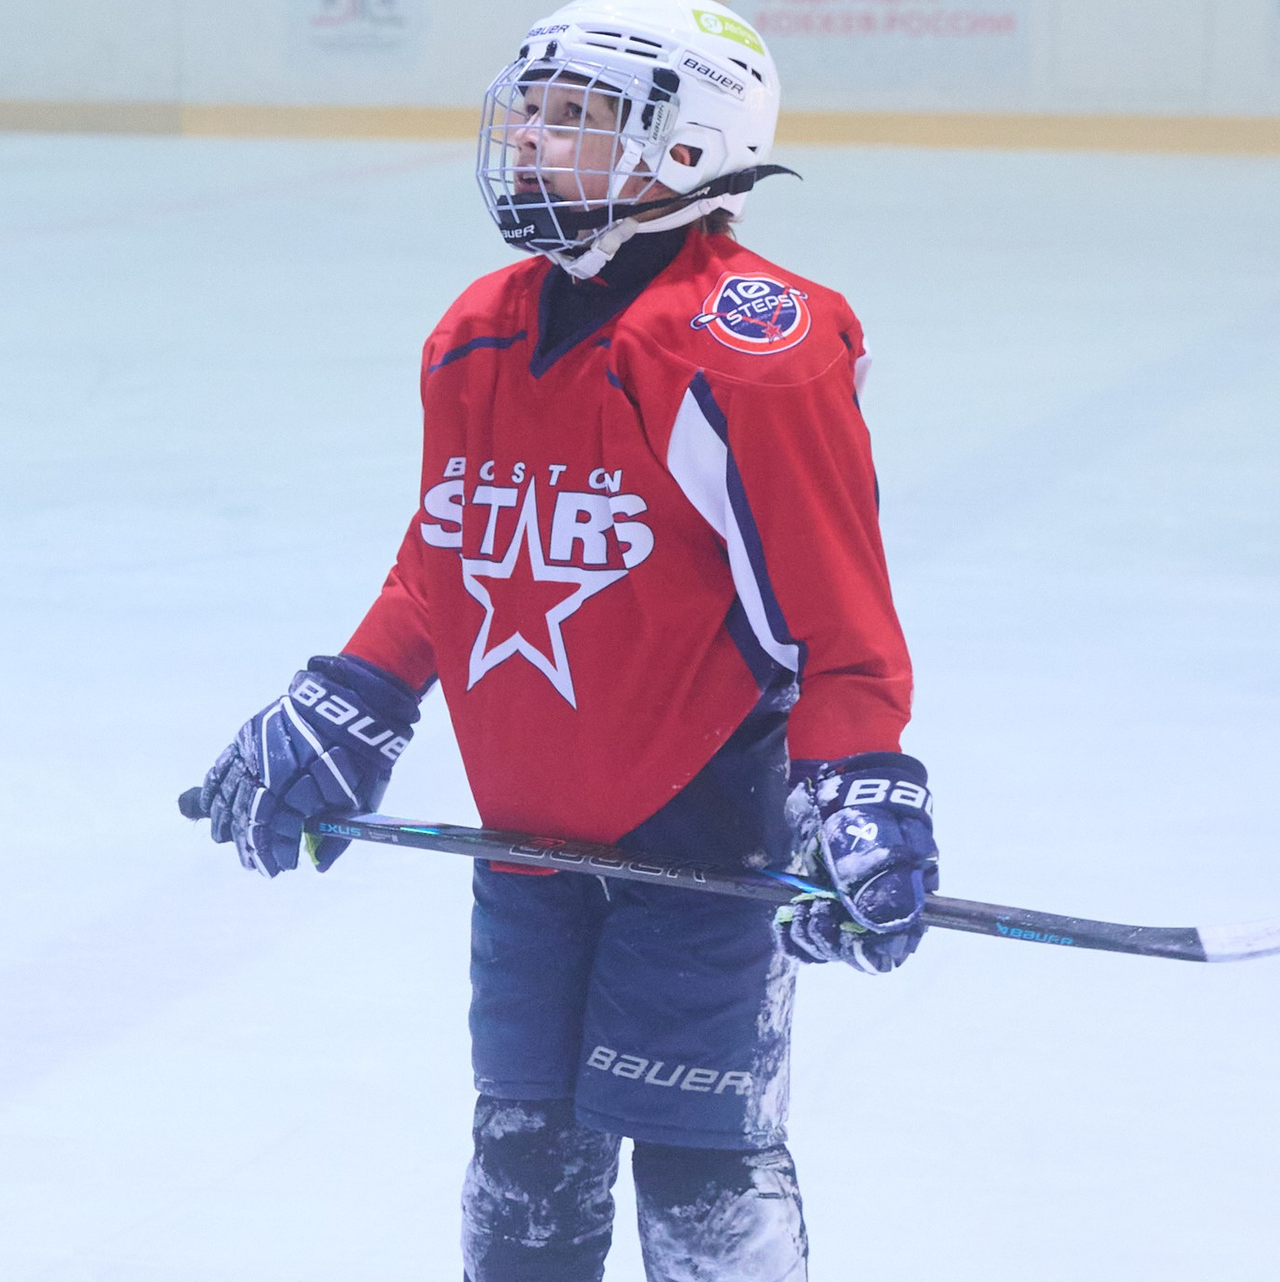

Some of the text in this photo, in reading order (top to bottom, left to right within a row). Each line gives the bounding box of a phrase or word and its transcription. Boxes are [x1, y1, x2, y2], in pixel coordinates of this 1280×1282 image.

[501, 224, 535, 238] AUER
[723, 281, 771, 305] 10
[726, 294, 794, 326] STEPS
[420, 474, 656, 570] STARS
[292, 678, 410, 760] BAUE
[319, 822, 362, 837] EXUS
